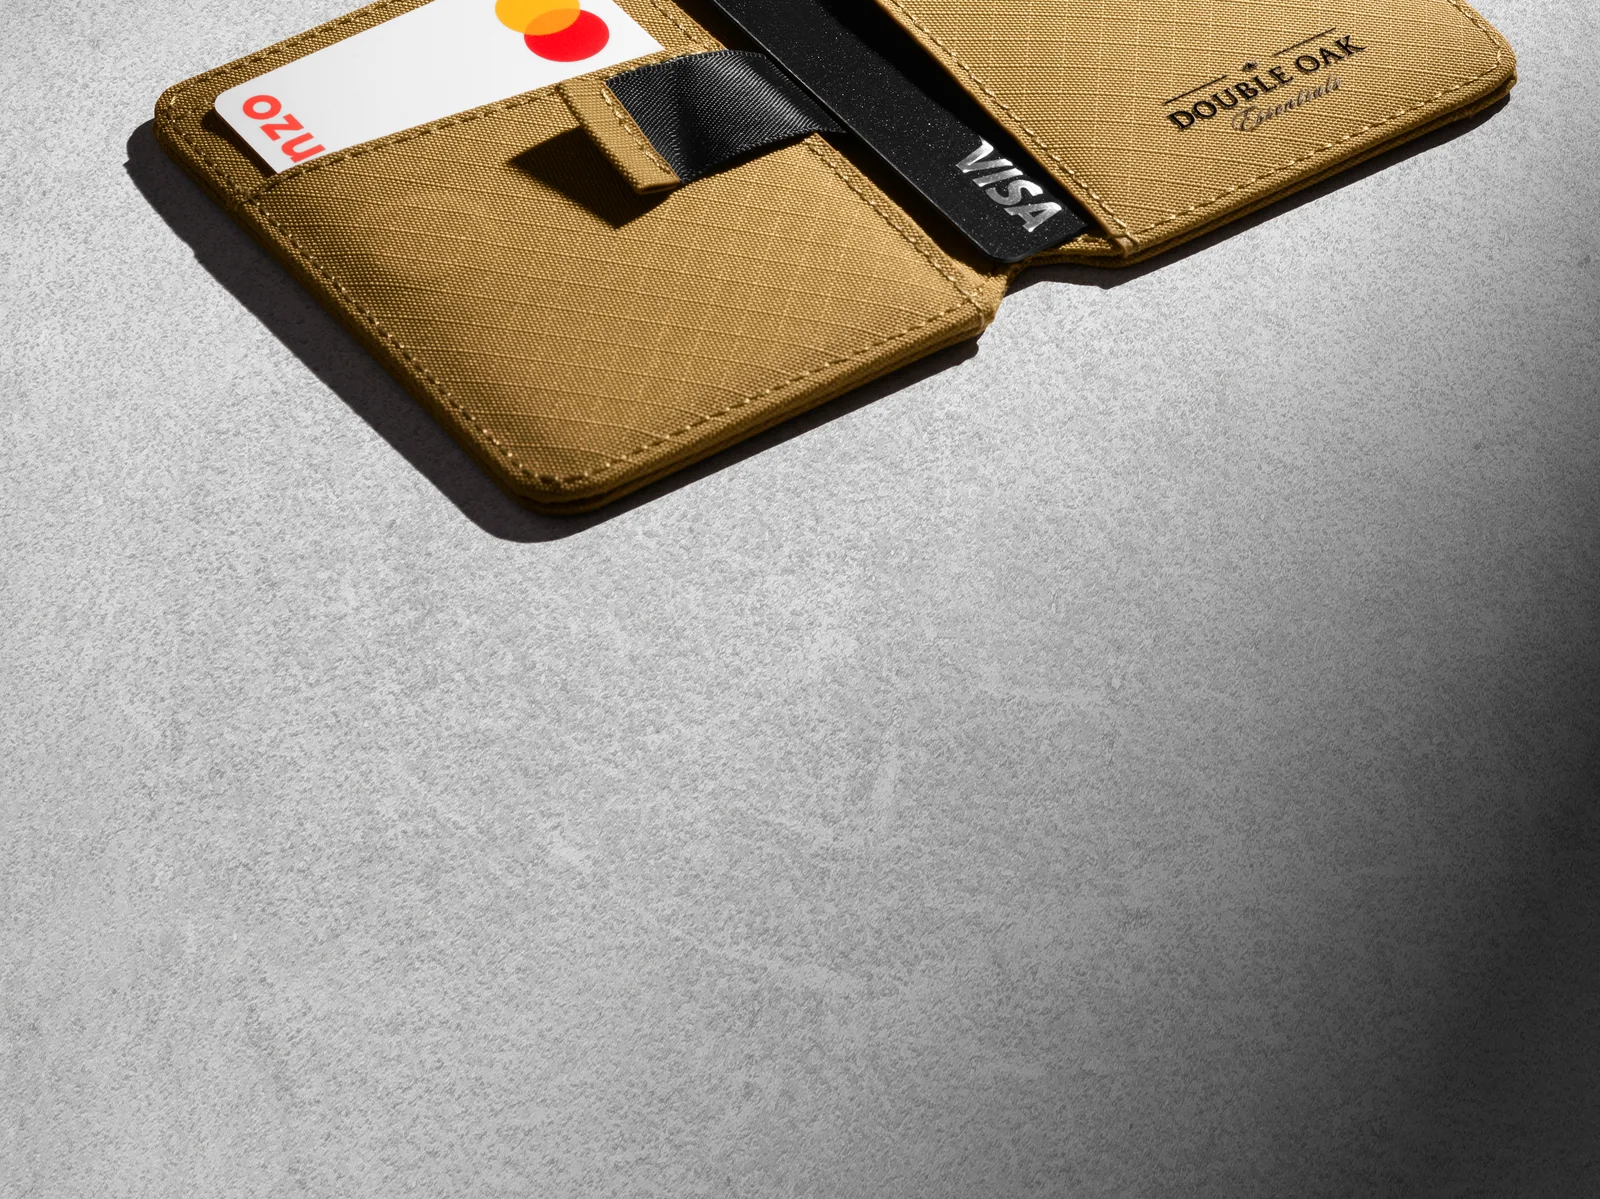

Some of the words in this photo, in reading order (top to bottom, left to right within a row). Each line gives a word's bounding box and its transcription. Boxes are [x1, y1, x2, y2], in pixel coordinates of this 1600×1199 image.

[1167, 64, 1294, 130] DOUBLE
[1294, 35, 1367, 73] OAK
[1231, 74, 1342, 132] Essentials
[955, 135, 1063, 233] VISA
